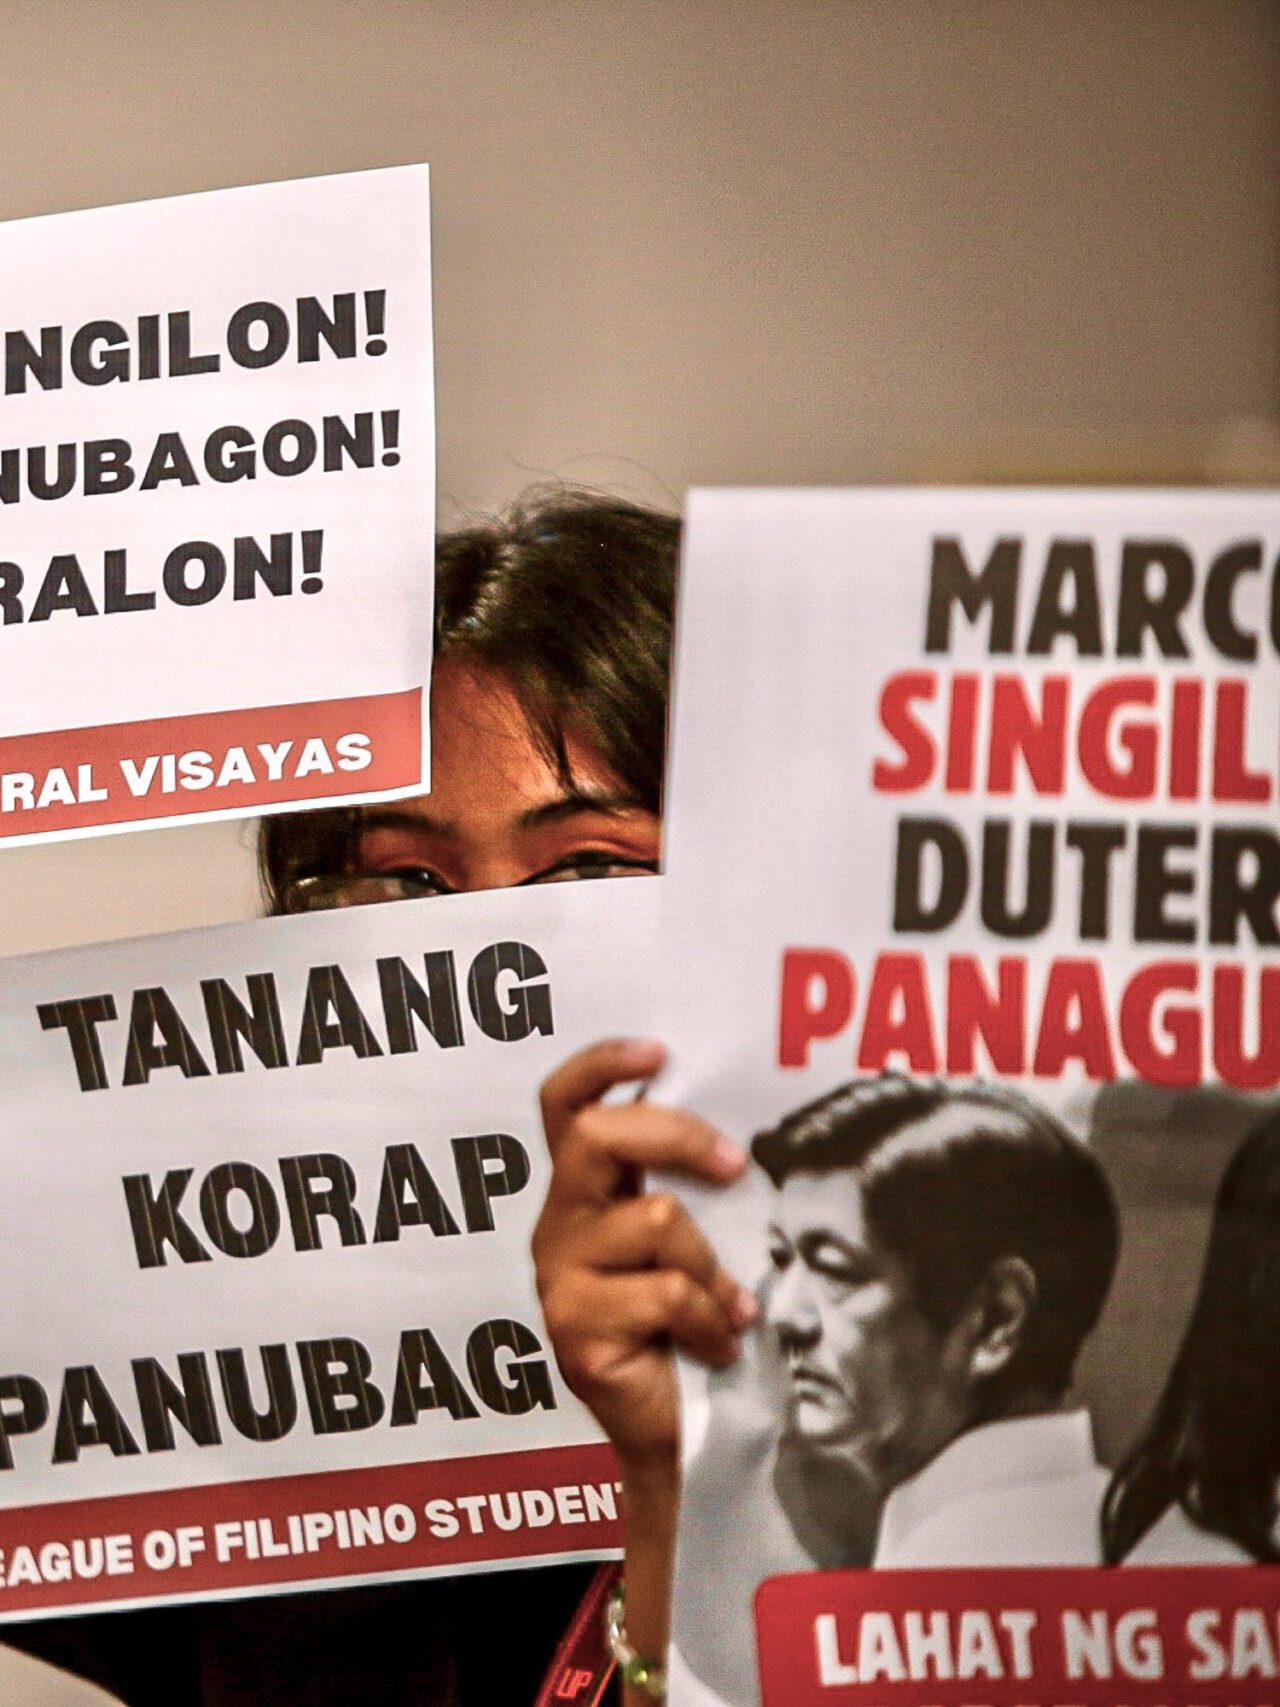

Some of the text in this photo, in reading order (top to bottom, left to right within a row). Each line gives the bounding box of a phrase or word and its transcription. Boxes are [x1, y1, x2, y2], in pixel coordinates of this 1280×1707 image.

[924, 533, 1280, 664] MARC
[119, 732, 373, 797] VISAYAS
[871, 669, 1273, 805] SINGIL
[892, 814, 1280, 948] DUTER
[35, 941, 555, 1093] TANANG
[776, 946, 1280, 1092] PANAGU
[121, 1133, 532, 1270] KORAP
[143, 1525, 206, 1571] OF
[214, 1503, 418, 1563] FILIPINO
[814, 1608, 1280, 1687] LAHAT NG SA
